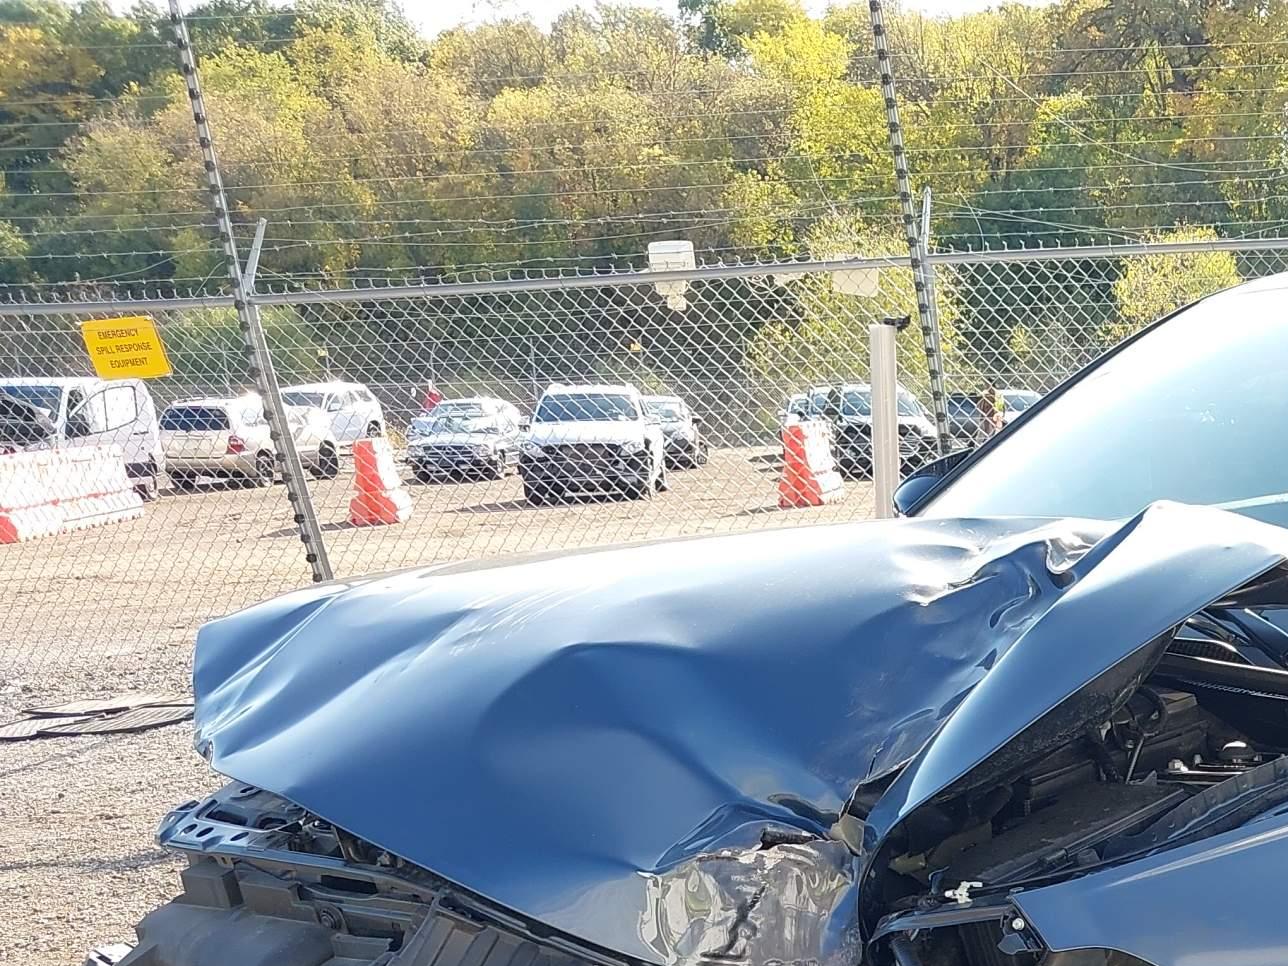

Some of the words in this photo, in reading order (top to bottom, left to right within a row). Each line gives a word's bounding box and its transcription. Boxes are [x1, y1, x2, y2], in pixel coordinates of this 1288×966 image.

[97, 328, 139, 340] EMERGENCY
[96, 344, 115, 355] SPILL
[115, 342, 152, 353] RESPONSE
[110, 357, 148, 368] EQUIPMENT
